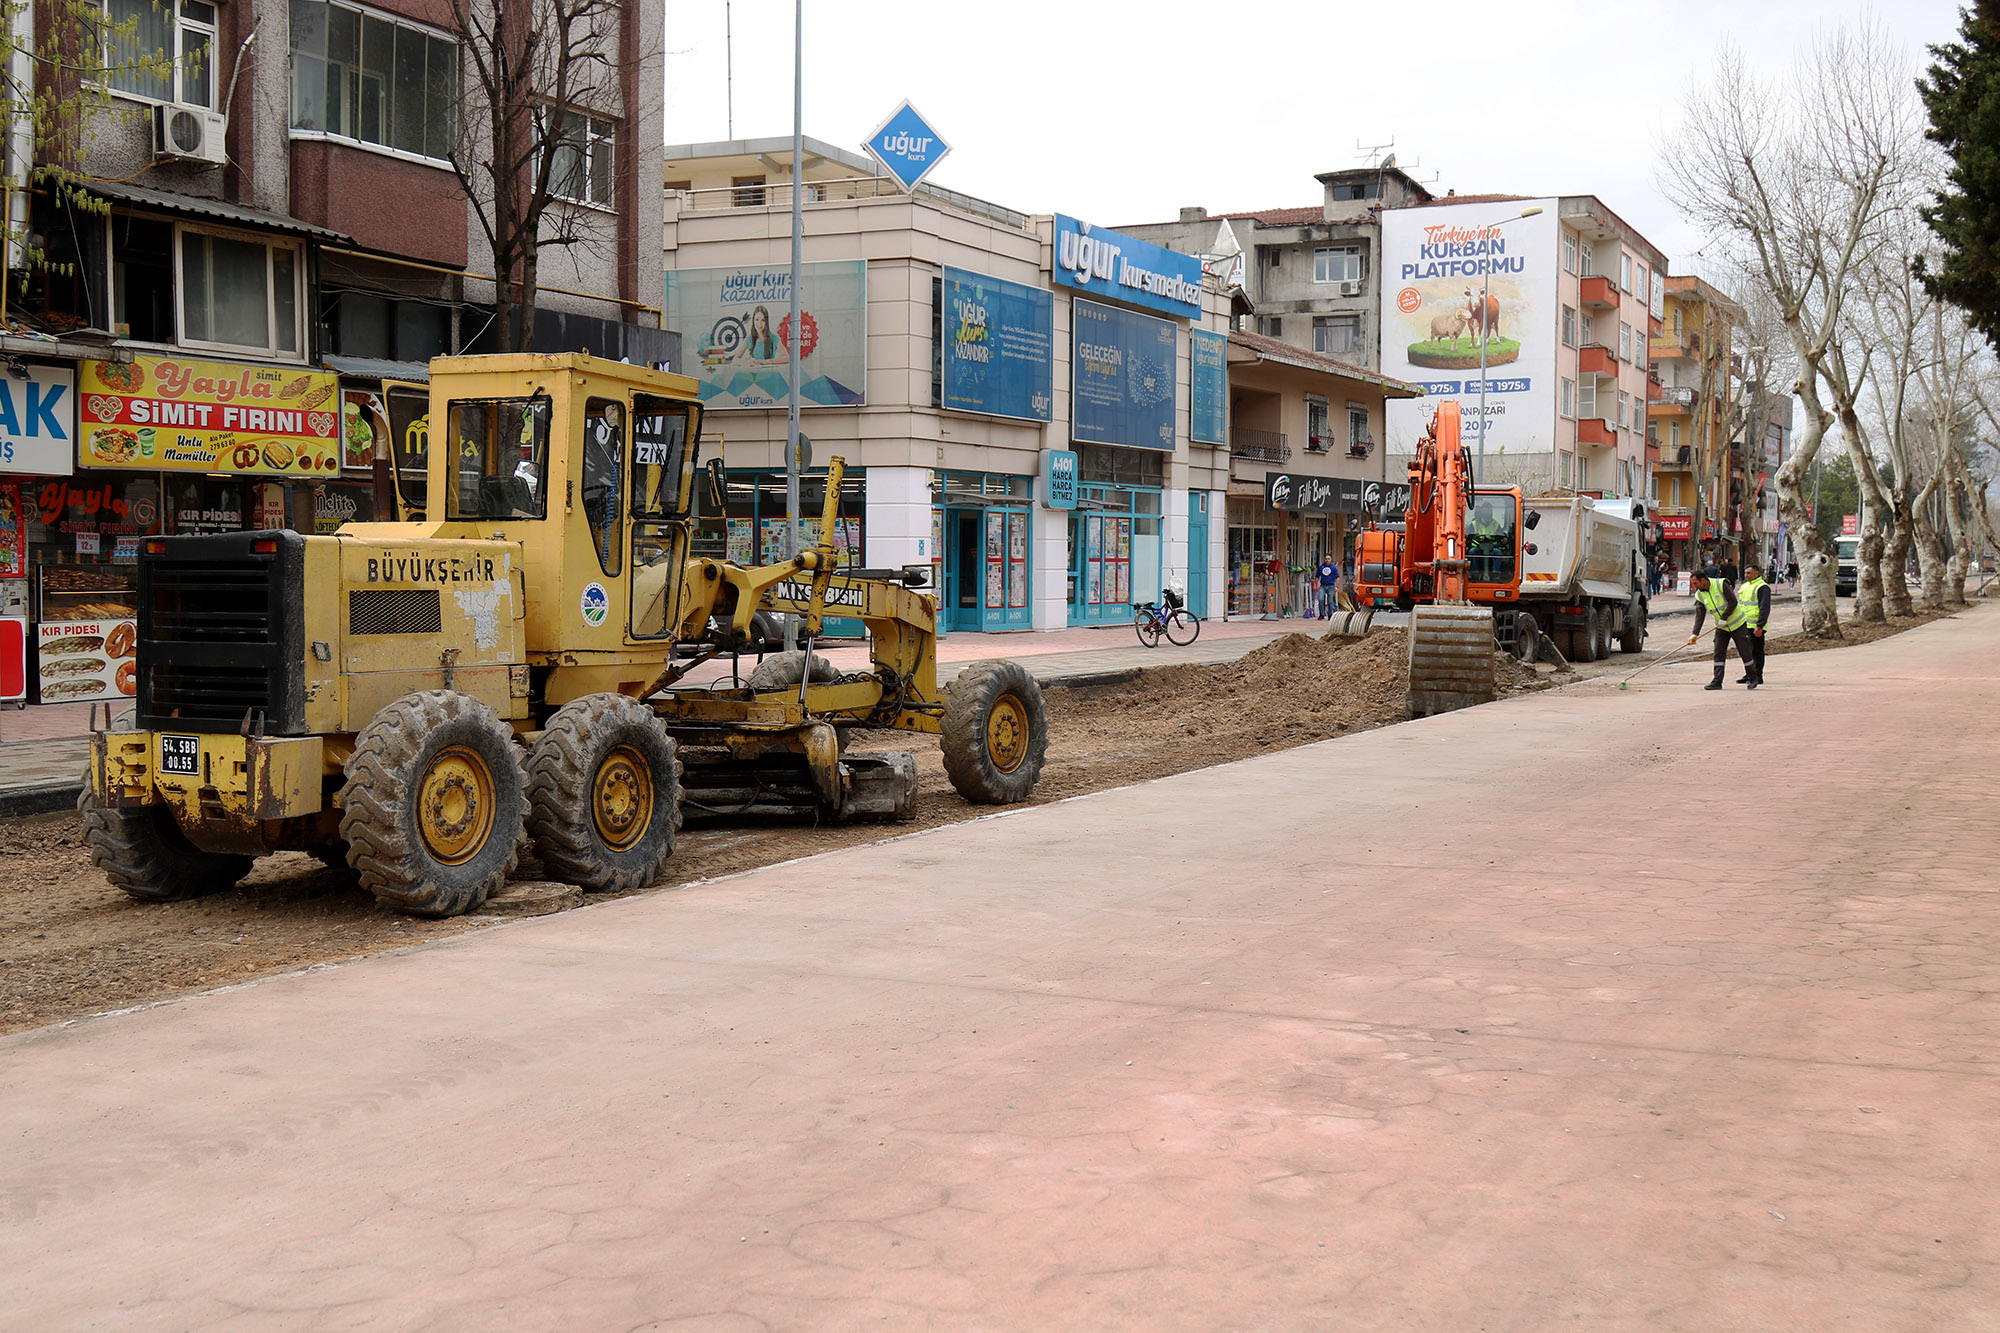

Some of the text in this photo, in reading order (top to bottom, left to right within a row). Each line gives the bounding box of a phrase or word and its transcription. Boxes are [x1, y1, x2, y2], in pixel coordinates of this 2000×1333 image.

[883, 131, 933, 156] uğur
[907, 152, 926, 161] kurs
[1424, 224, 1502, 247] Türkiye'nin
[1059, 221, 1121, 284] uğur
[1420, 238, 1505, 260] KURBAN
[1401, 256, 1525, 280] PLATFORMU
[154, 362, 282, 403] Yayla simit
[223, 406, 303, 434] FIRINI
[176, 434, 203, 448] Unlu
[164, 449, 217, 463] Mamüller
[1053, 471, 1072, 481] HARCA
[1053, 481, 1072, 491] HARCA
[39, 482, 130, 525] Yayla
[178, 510, 200, 521] KIR
[60, 520, 138, 535] SİMİT FIRINI
[367, 551, 494, 585] BÜYÜKŞEHİR
[778, 582, 863, 606] MITSBISHI
[41, 623, 100, 636] KIR PİDESİ
[179, 741, 197, 754] SBB
